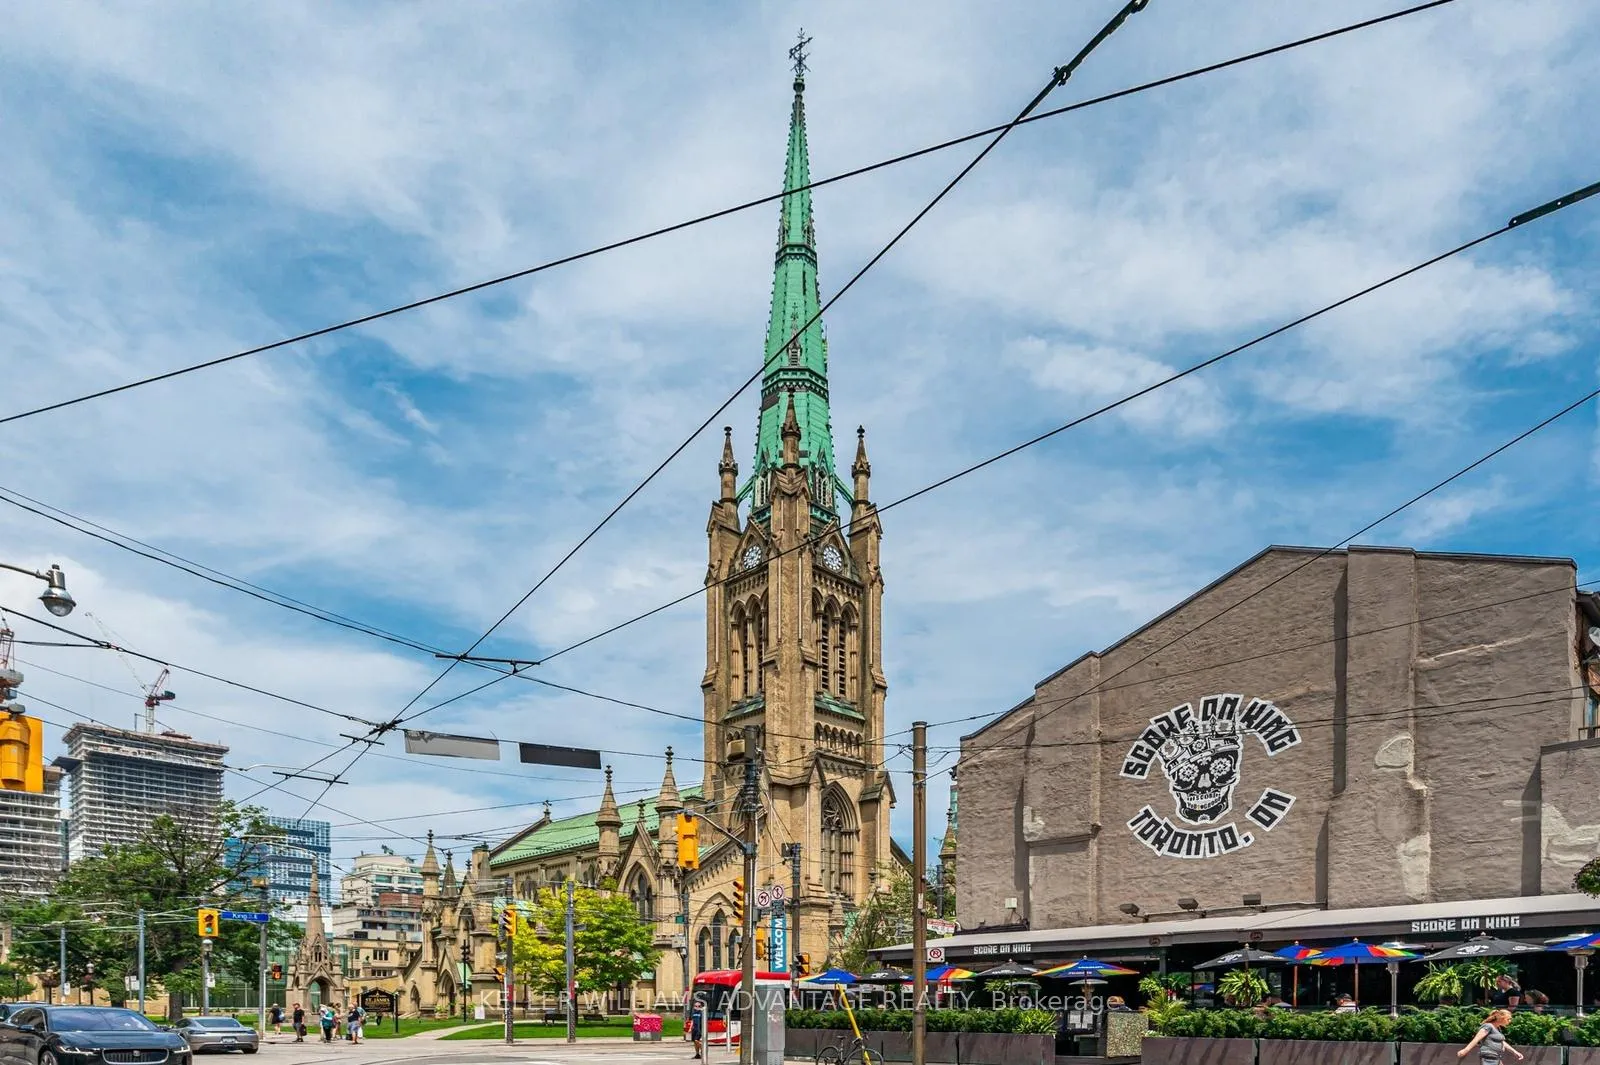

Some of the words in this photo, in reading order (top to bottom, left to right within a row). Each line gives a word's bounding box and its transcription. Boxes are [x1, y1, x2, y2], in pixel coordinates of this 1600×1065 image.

[1120, 703, 1196, 778] SCORE
[1200, 694, 1243, 722] ON
[1239, 698, 1301, 755] KING
[1246, 788, 1296, 831] ON
[774, 917, 784, 969] WELCOM
[1411, 920, 1457, 933] SCORE
[1461, 918, 1480, 929] ON
[1485, 916, 1520, 929] KING
[973, 945, 998, 955] SCORE
[1000, 944, 1011, 953] ON
[1012, 943, 1032, 954] KING
